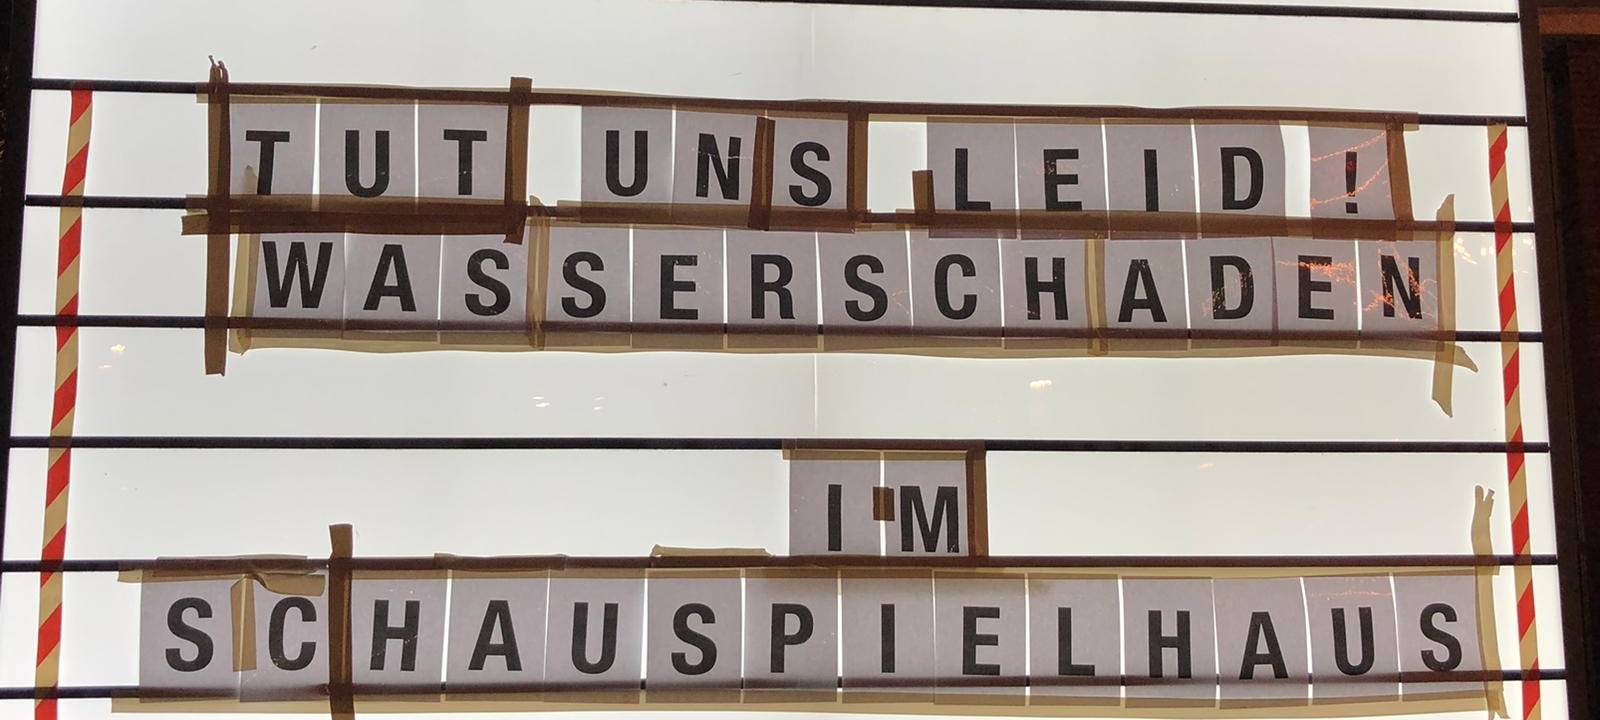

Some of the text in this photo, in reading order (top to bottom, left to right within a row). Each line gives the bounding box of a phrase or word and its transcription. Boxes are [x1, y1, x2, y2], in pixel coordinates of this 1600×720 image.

[246, 130, 487, 199] TUT
[605, 131, 832, 207] UNS
[954, 147, 1265, 213] LEID
[261, 241, 1423, 324] WASSERSCHADEN
[827, 484, 960, 555] IM
[165, 597, 1464, 680] SCHAUSPIELHAUS
